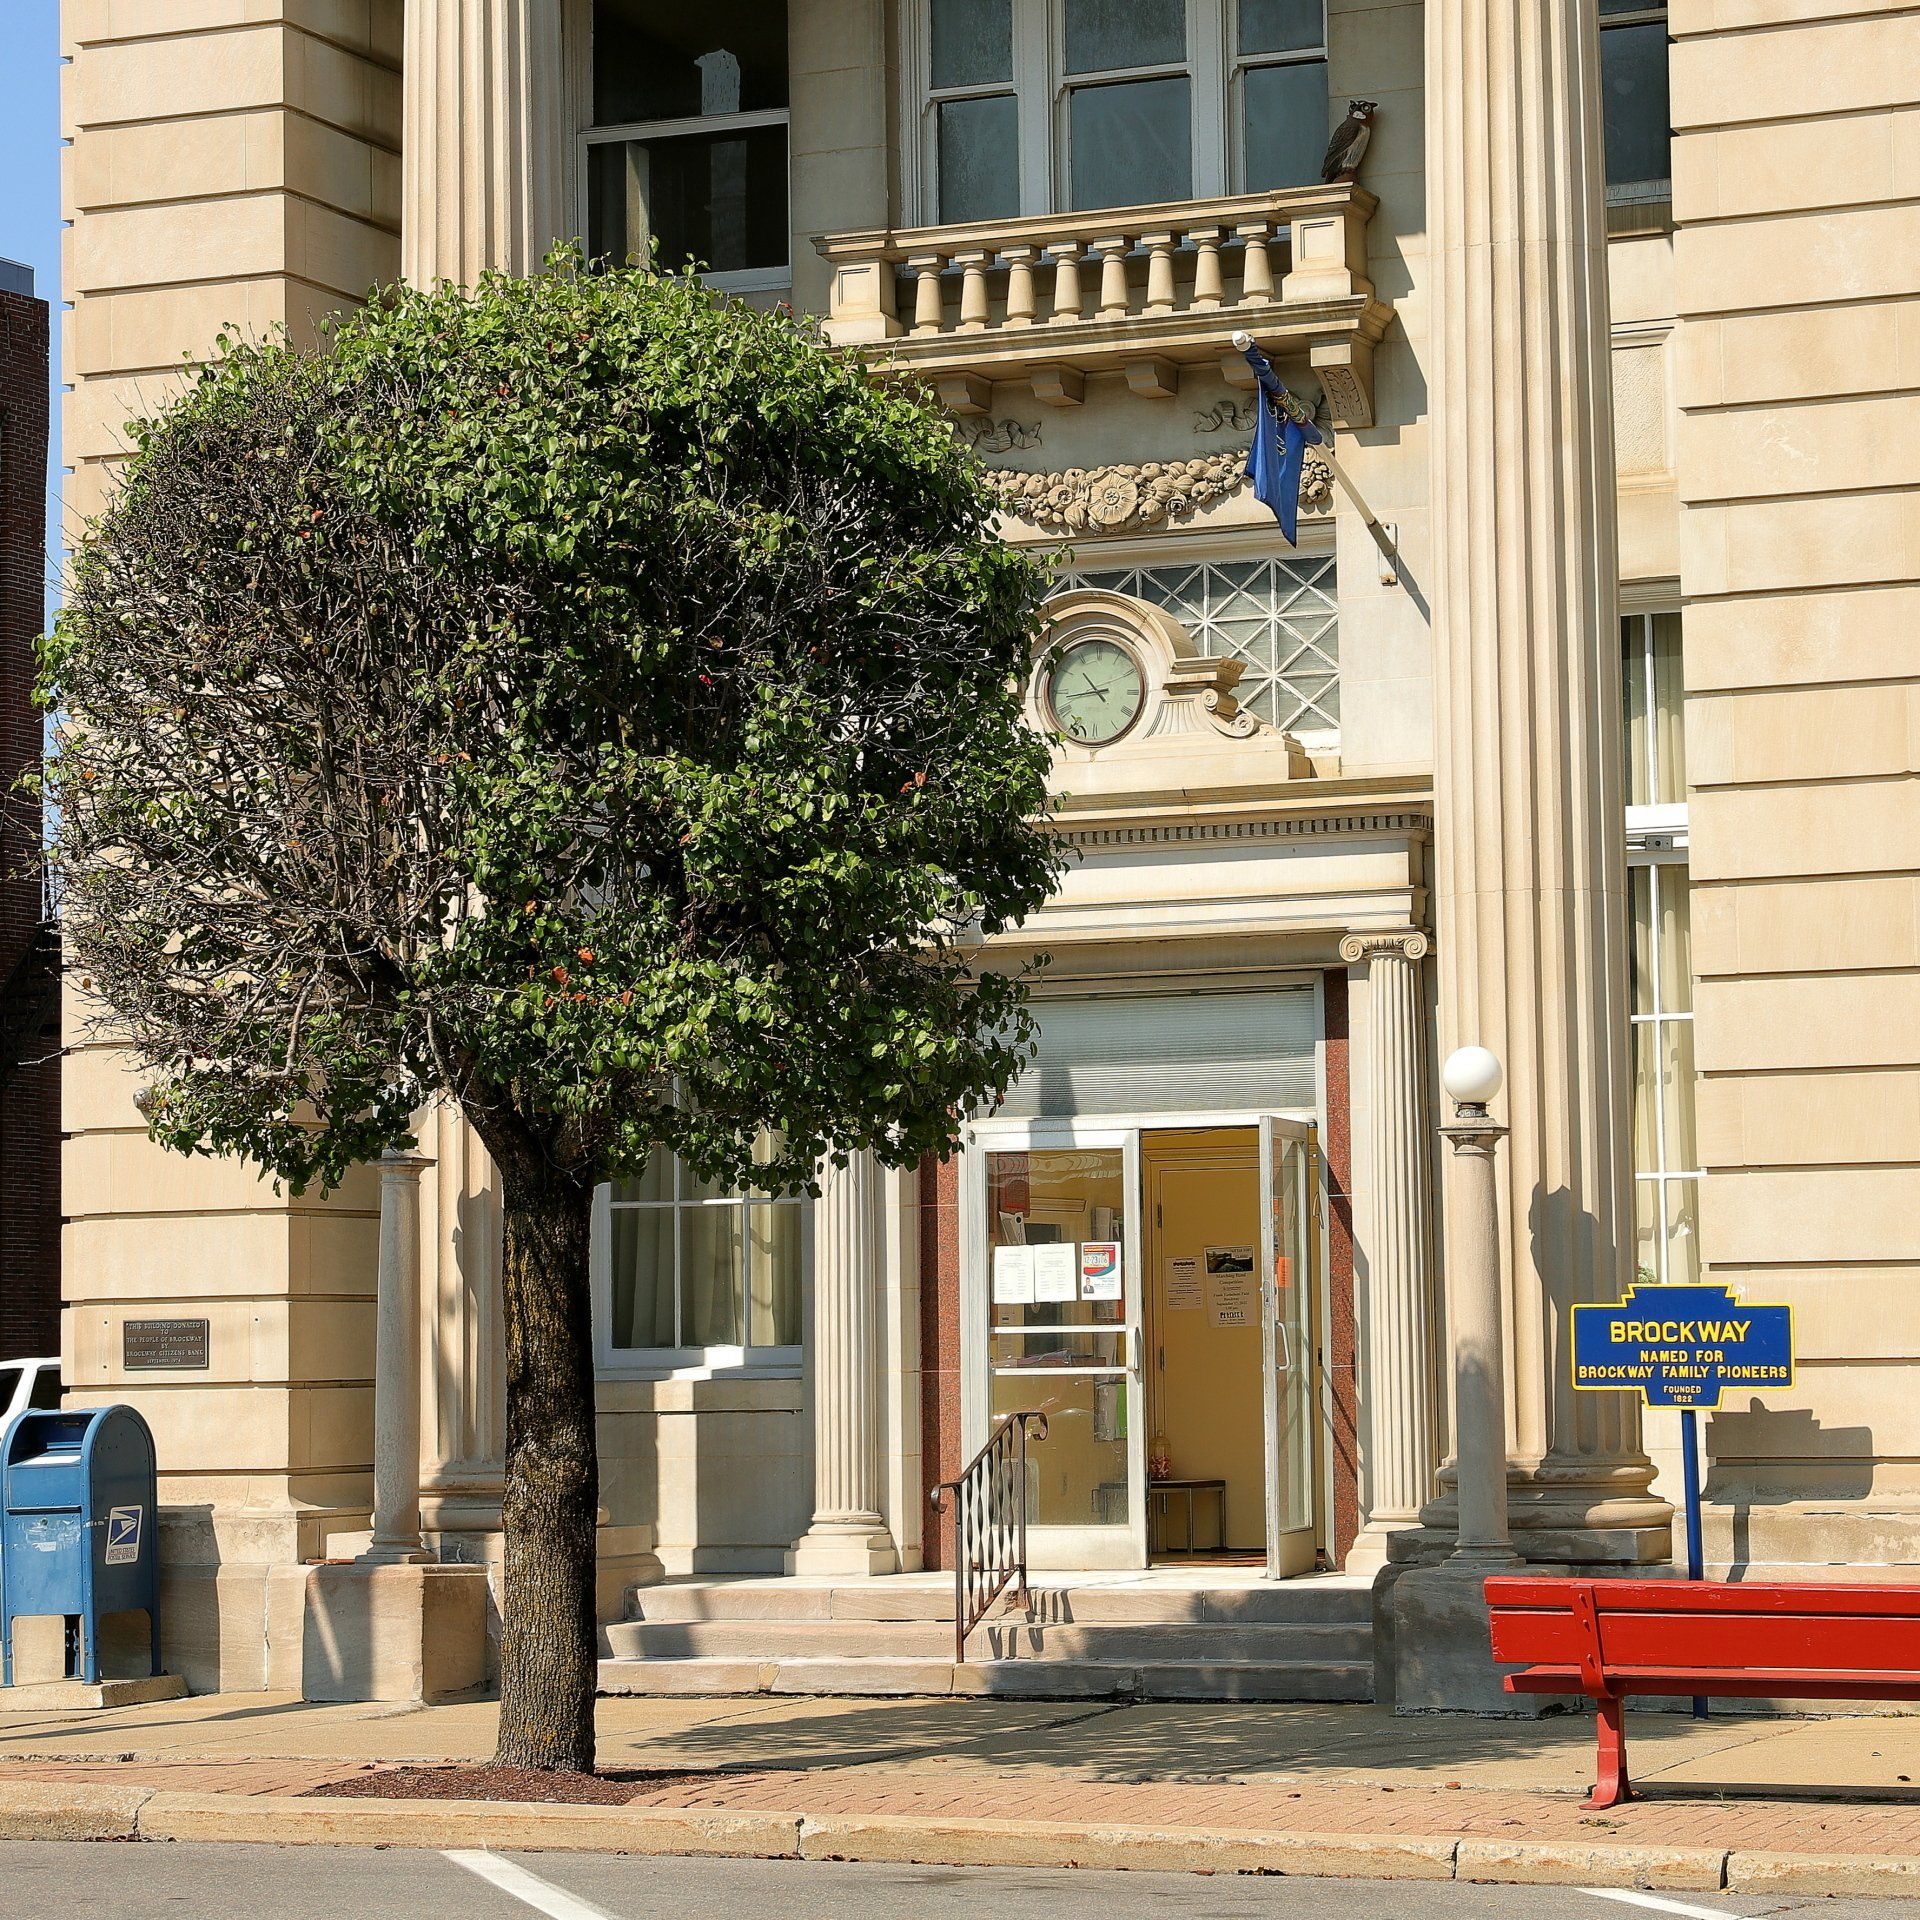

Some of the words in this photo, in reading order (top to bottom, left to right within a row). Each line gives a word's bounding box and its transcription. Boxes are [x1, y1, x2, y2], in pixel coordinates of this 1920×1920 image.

[144, 1322, 171, 1330] BUILDING
[173, 1321, 201, 1329] DONATED
[1610, 1321, 1751, 1343] BROCKWAY
[1640, 1350, 1689, 1363] NAMED
[1696, 1350, 1724, 1362] FOR
[1578, 1364, 1655, 1379] BROCKWAY
[1662, 1365, 1710, 1379] FAMILY
[1717, 1365, 1788, 1379] PIONEERS
[1663, 1385, 1702, 1394] FOUNDED
[1673, 1394, 1693, 1403] 1822
